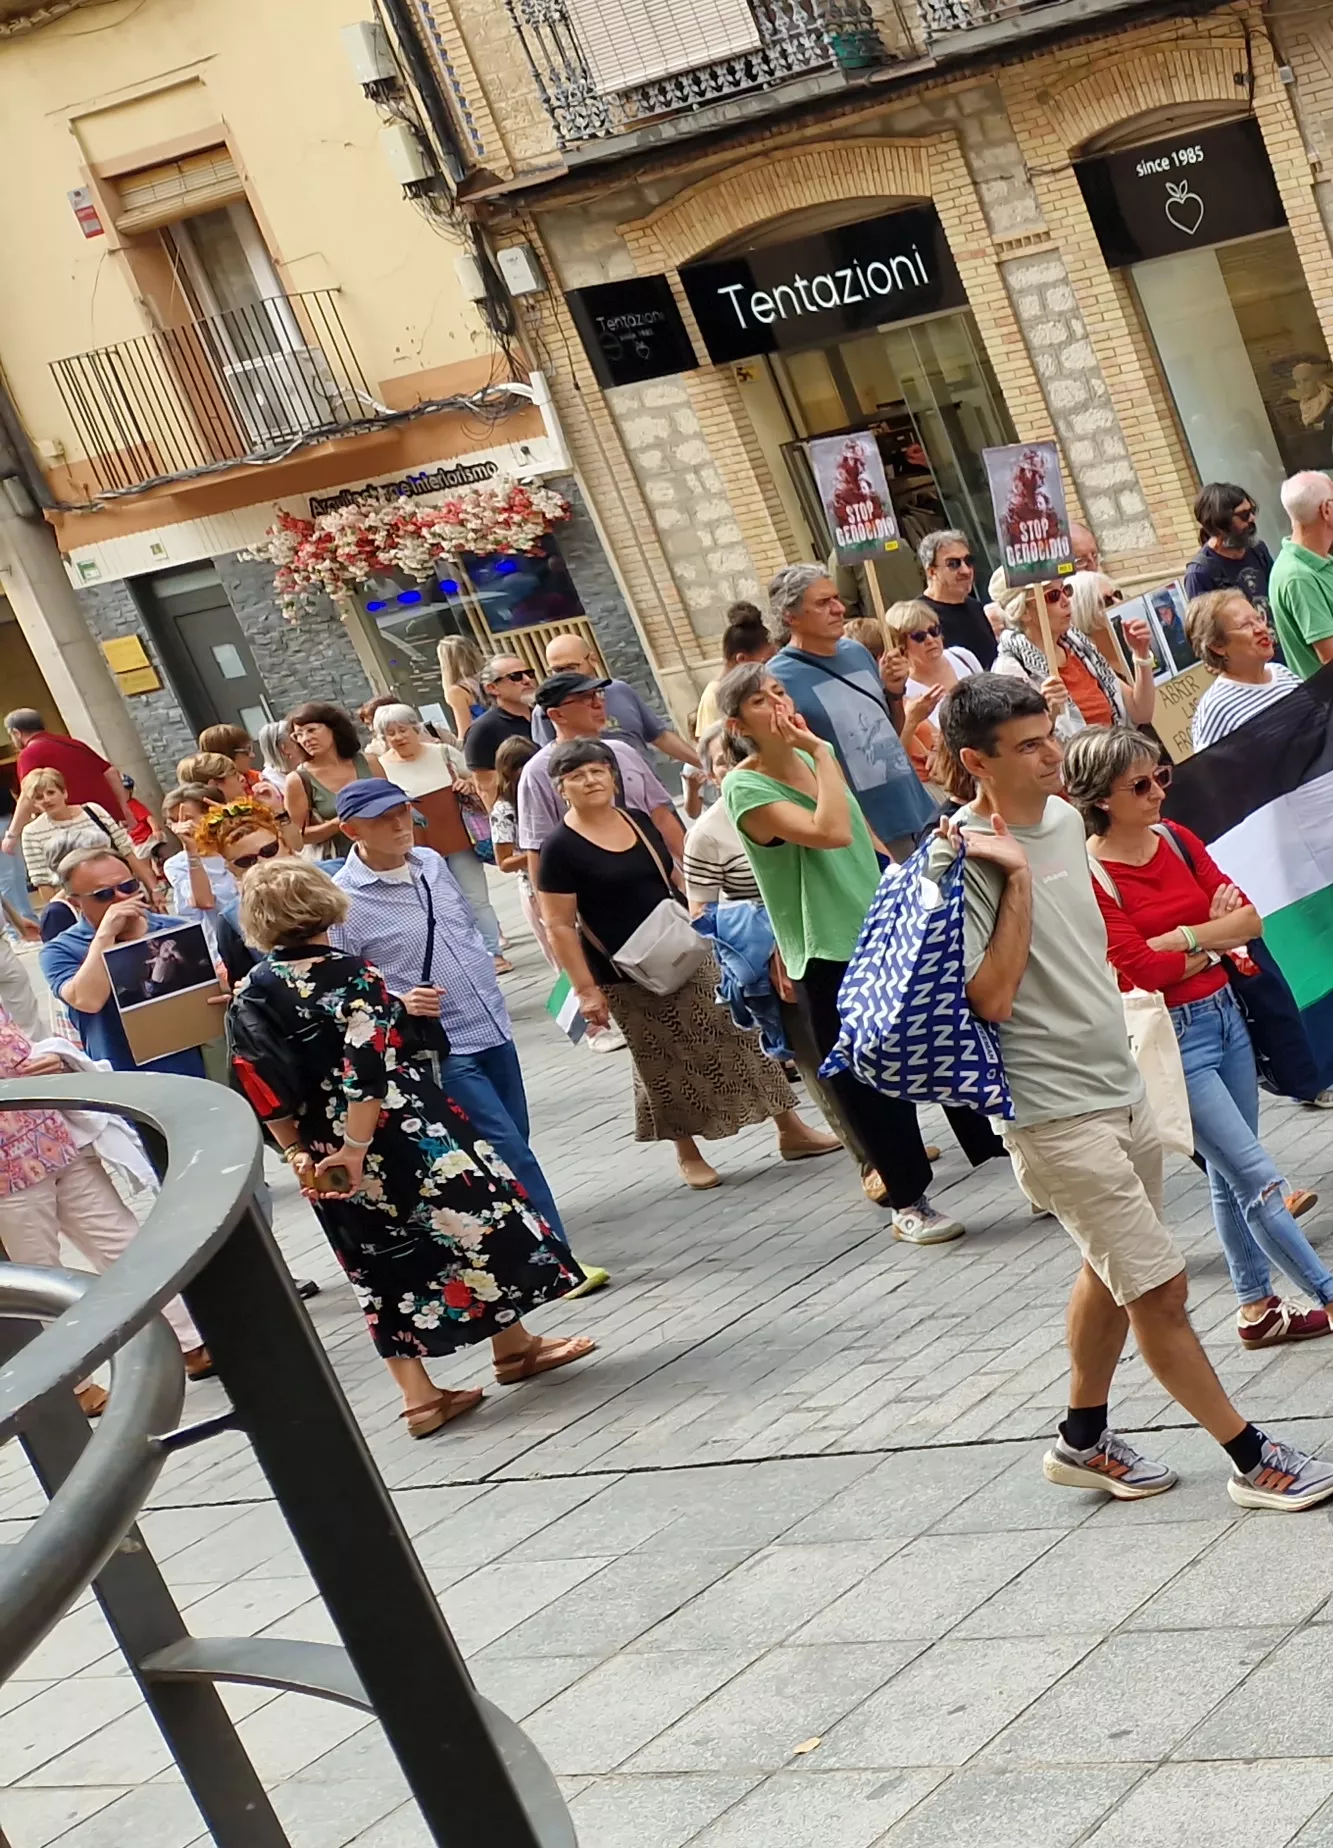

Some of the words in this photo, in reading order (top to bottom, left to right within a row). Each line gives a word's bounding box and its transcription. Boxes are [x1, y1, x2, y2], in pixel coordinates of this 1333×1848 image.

[1136, 155, 1171, 177] since
[1171, 145, 1204, 168] 1985
[717, 243, 930, 330] Tentazioni
[411, 461, 499, 494] Interiorismo
[846, 500, 874, 524] STOP
[835, 516, 895, 547] GENOCIDIO
[1019, 517, 1049, 542] STOP
[1006, 535, 1070, 567] GENOCIDIO
[1158, 675, 1201, 709] ABRIR
